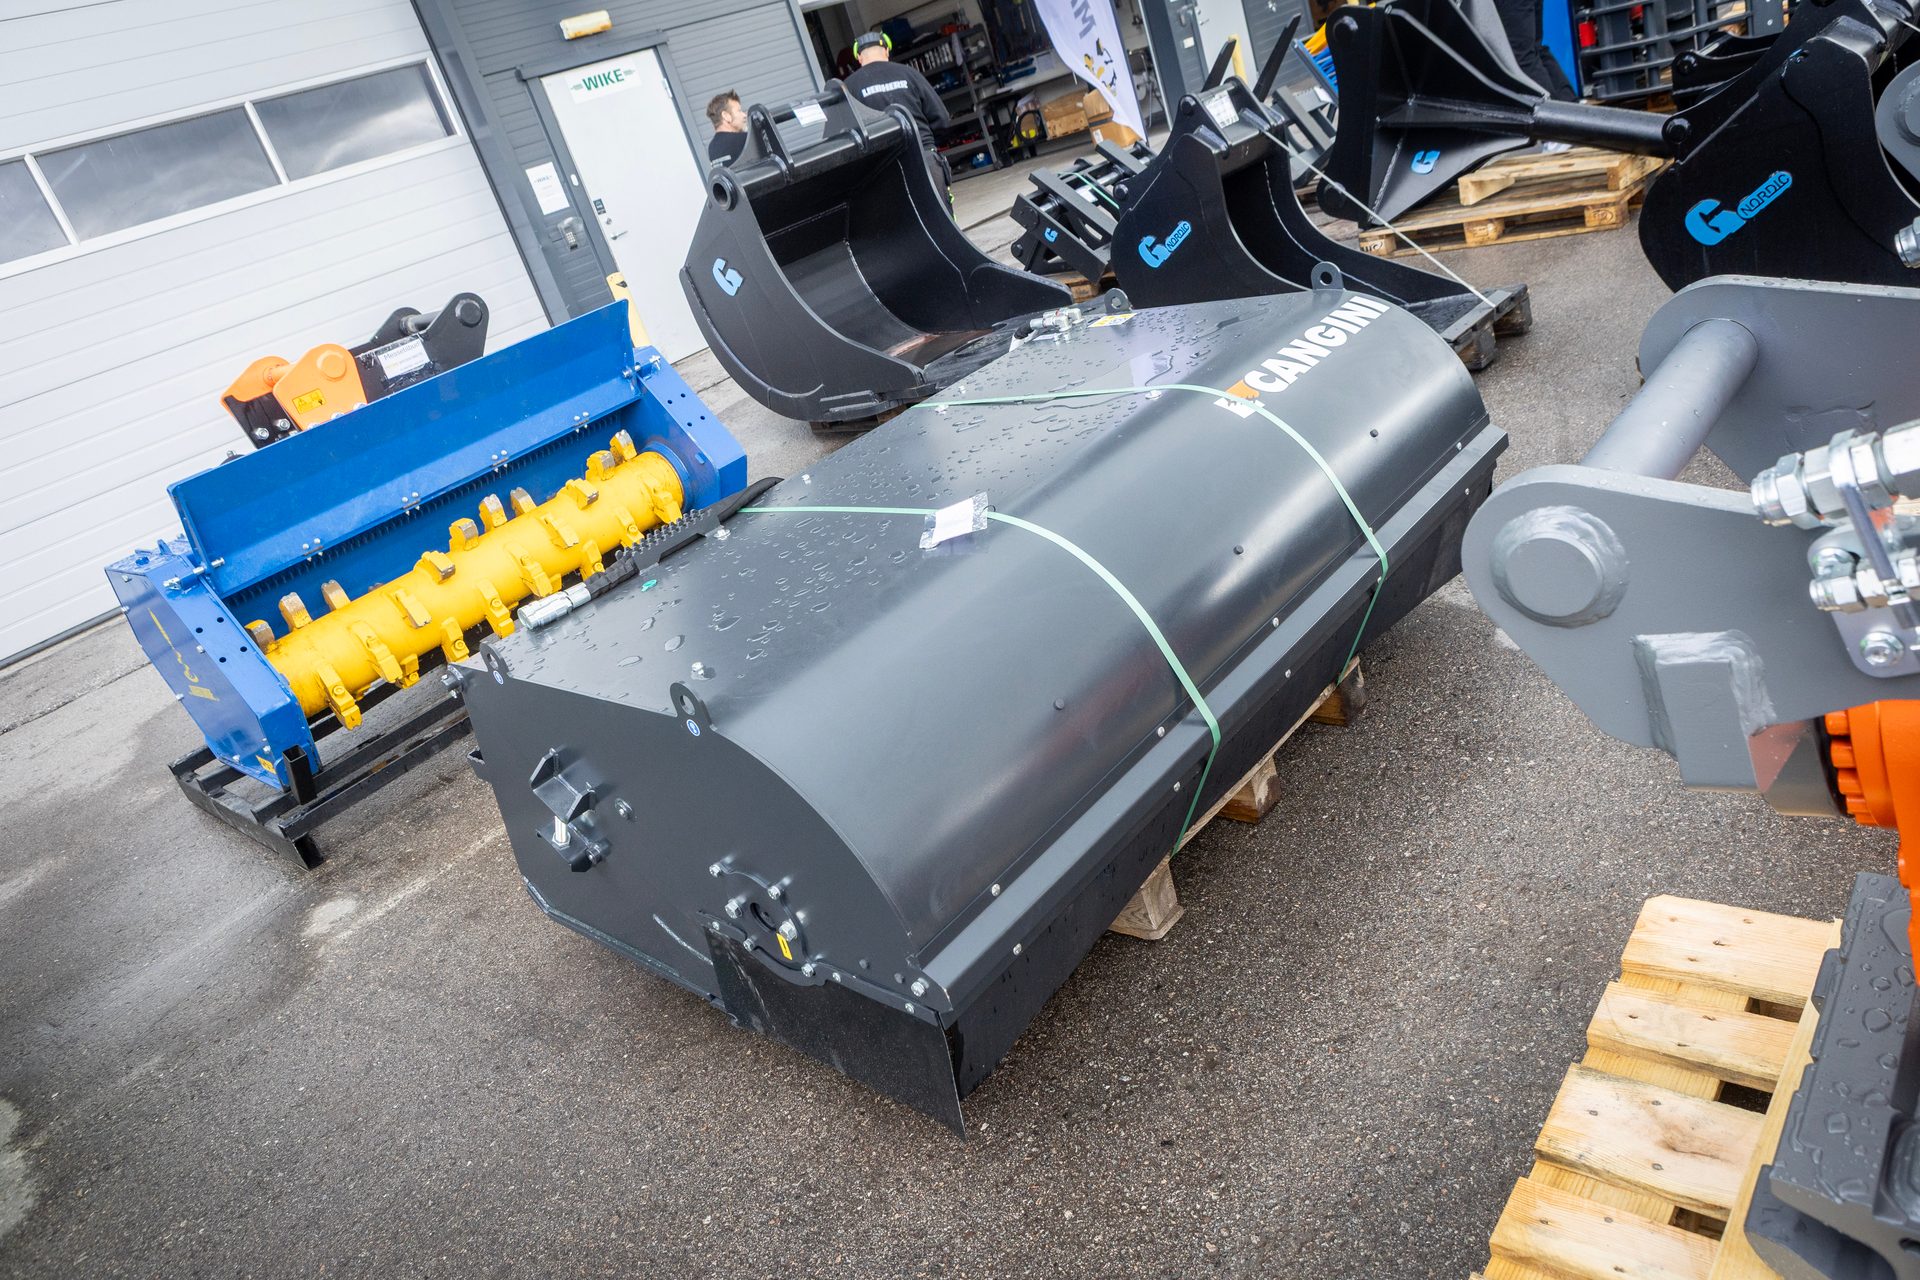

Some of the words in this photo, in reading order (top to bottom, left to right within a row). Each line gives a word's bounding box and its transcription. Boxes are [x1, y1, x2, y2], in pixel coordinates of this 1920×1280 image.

[582, 68, 625, 91] WIKE
[861, 80, 908, 98] LIEBHERR
[1740, 174, 1790, 216] NORDIC
[1166, 222, 1190, 250] NORDIC
[1244, 295, 1391, 393] CANGINI
